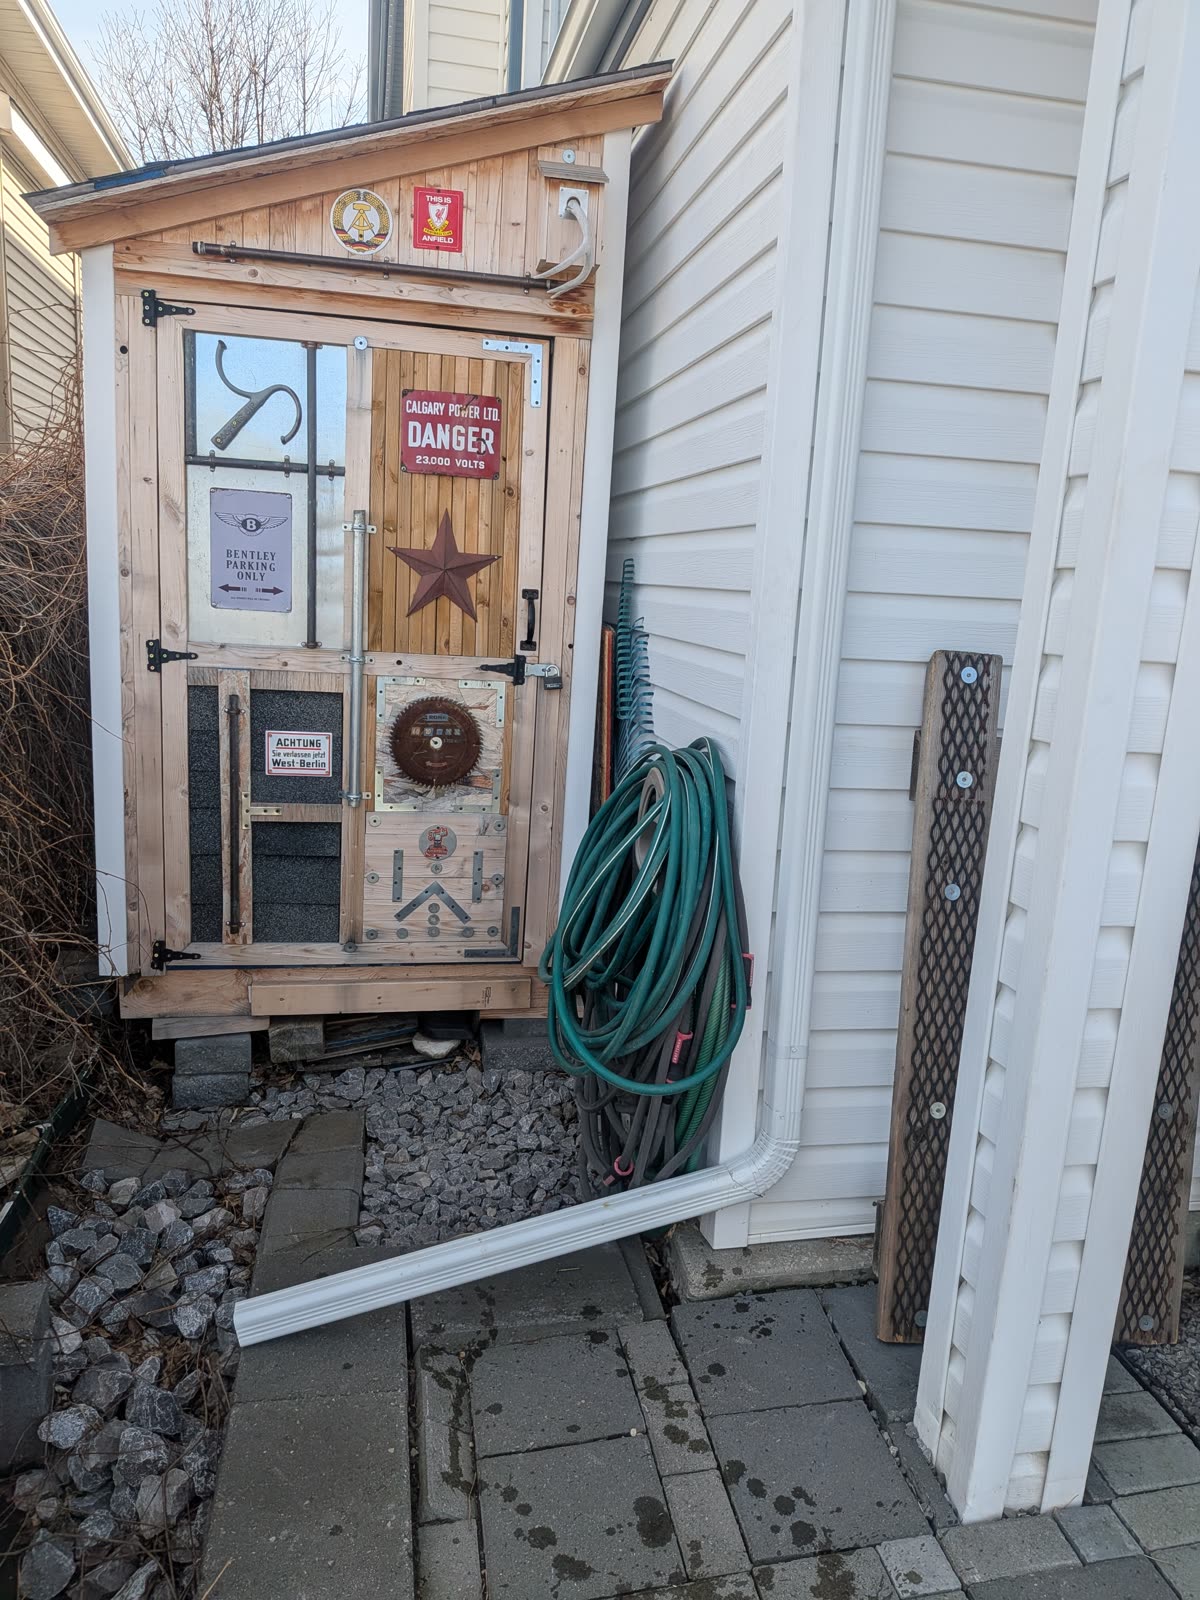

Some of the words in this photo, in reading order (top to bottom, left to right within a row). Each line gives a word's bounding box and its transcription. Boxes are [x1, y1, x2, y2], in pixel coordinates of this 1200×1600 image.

[426, 195, 443, 203] THIS
[422, 235, 454, 243] ANFIELD
[406, 400, 445, 416] CALGARY
[448, 403, 480, 420] POWER
[483, 407, 501, 422] LTD.
[408, 421, 495, 455] DANGER
[455, 458, 485, 470] VOLTS
[246, 519, 257, 531] B
[226, 549, 276, 561] BENTLEY
[226, 560, 276, 572] PARKING
[237, 571, 265, 581] ONLY
[276, 738, 321, 747] ACHTUNG
[312, 751, 326, 759] jetzt
[272, 758, 326, 767] West-Berlin
